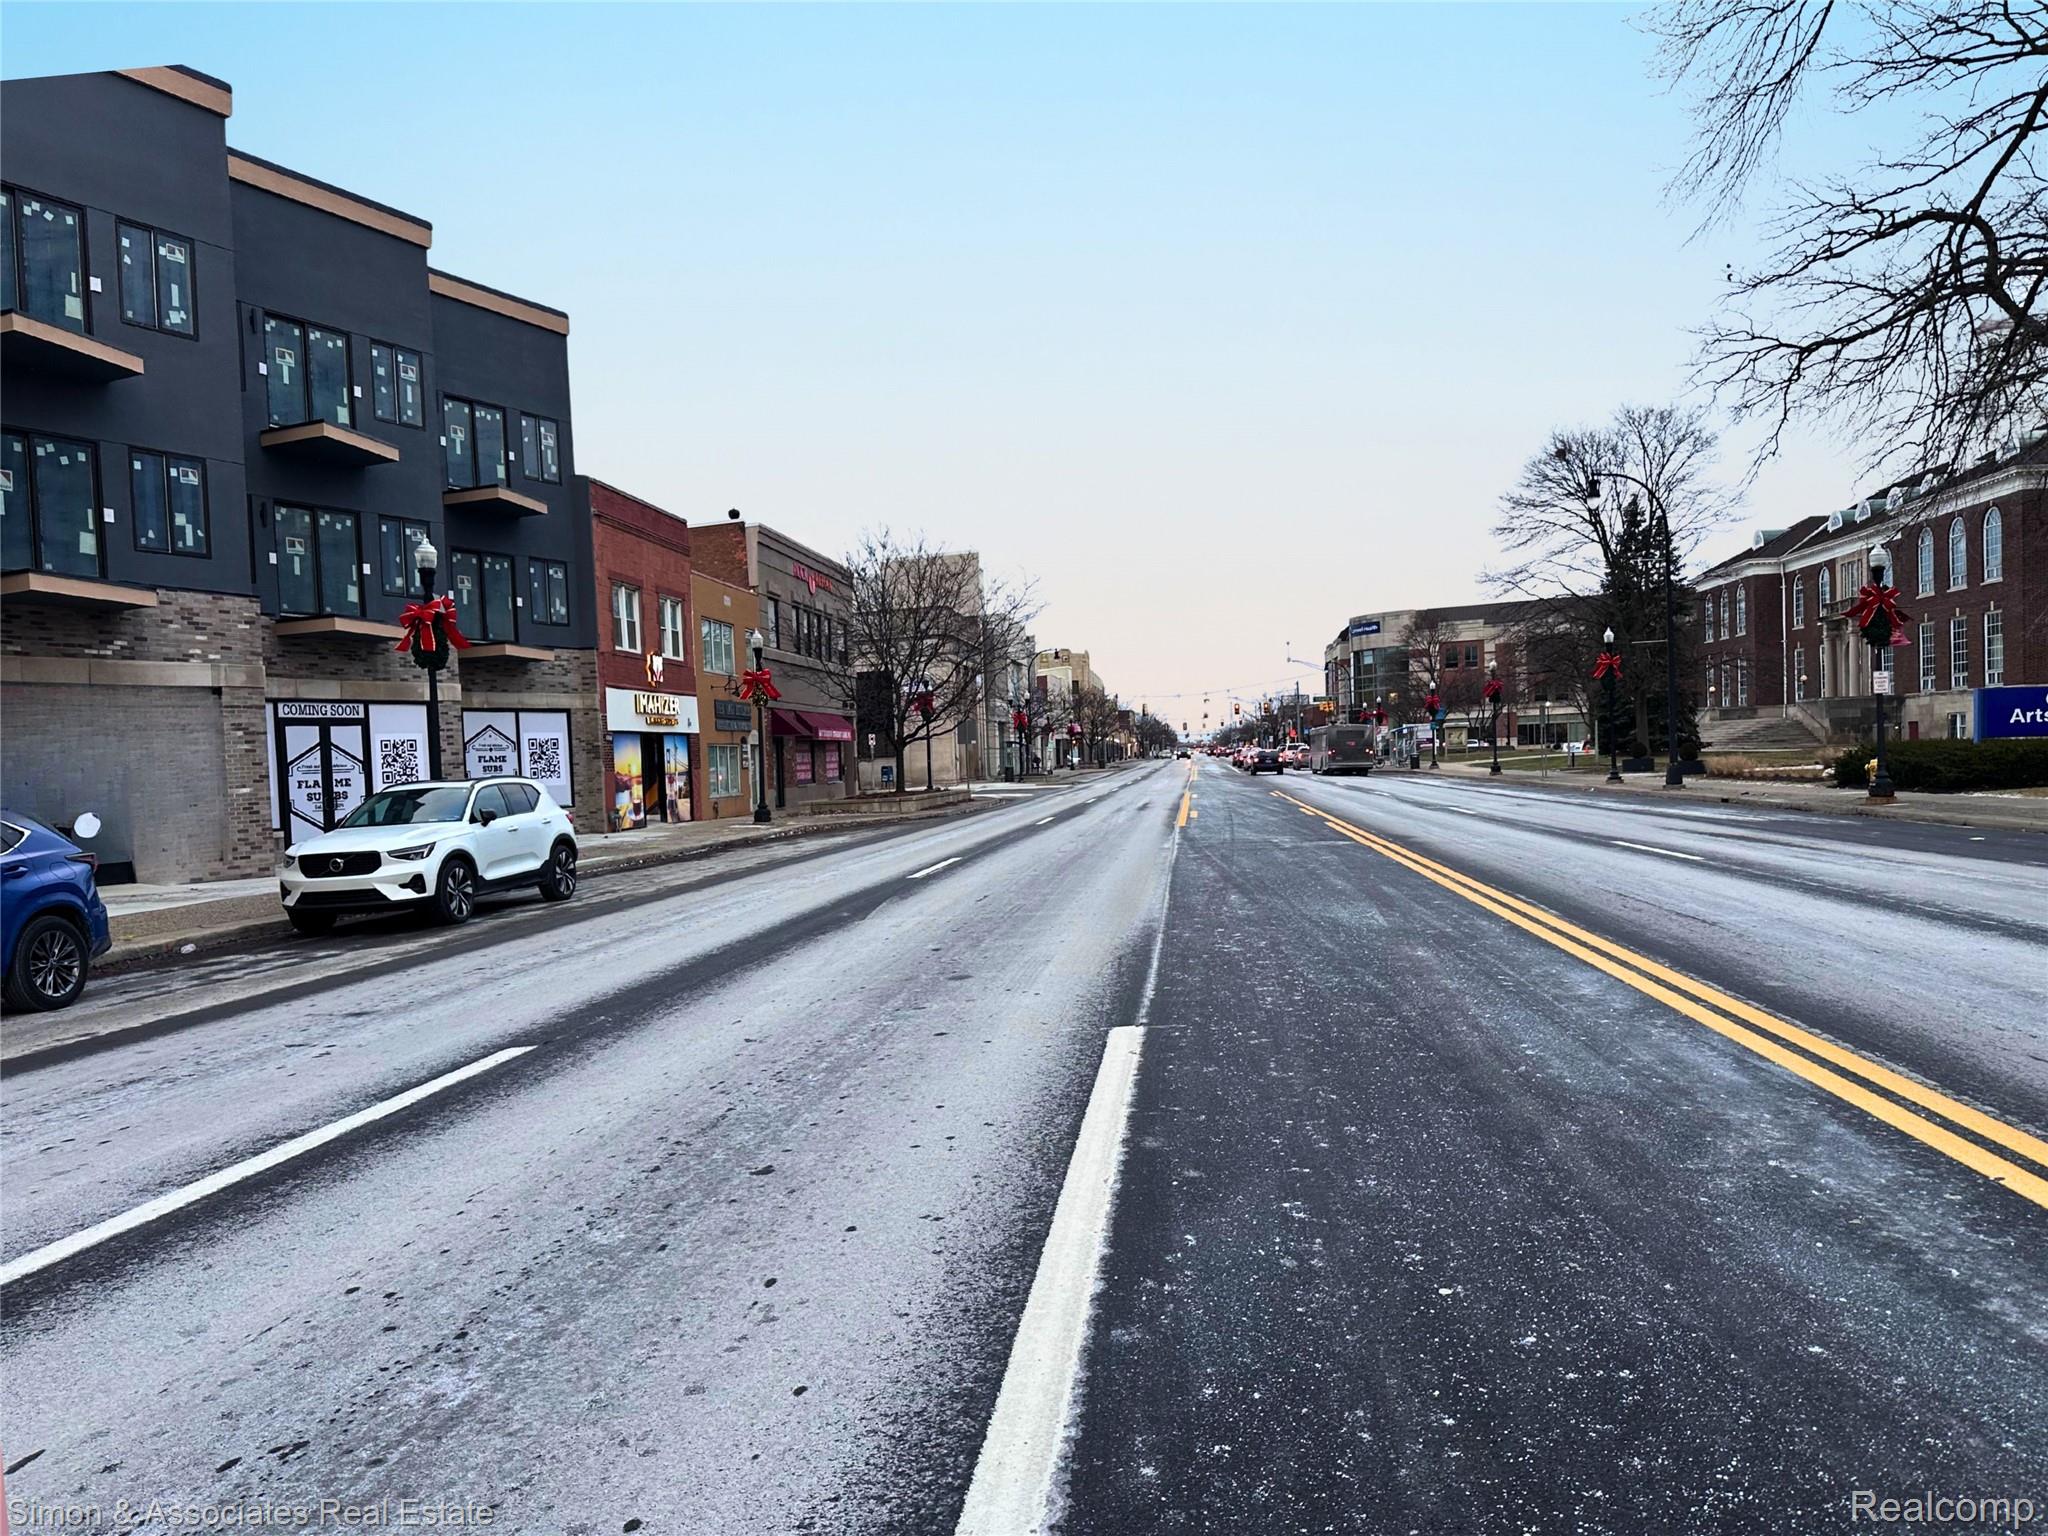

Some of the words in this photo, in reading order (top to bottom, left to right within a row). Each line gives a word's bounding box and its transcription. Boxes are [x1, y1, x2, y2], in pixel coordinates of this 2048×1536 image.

[282, 704, 328, 716] COMING
[330, 705, 360, 716] SOON
[478, 755, 507, 763] FLAME
[482, 765, 503, 773] SUBS
